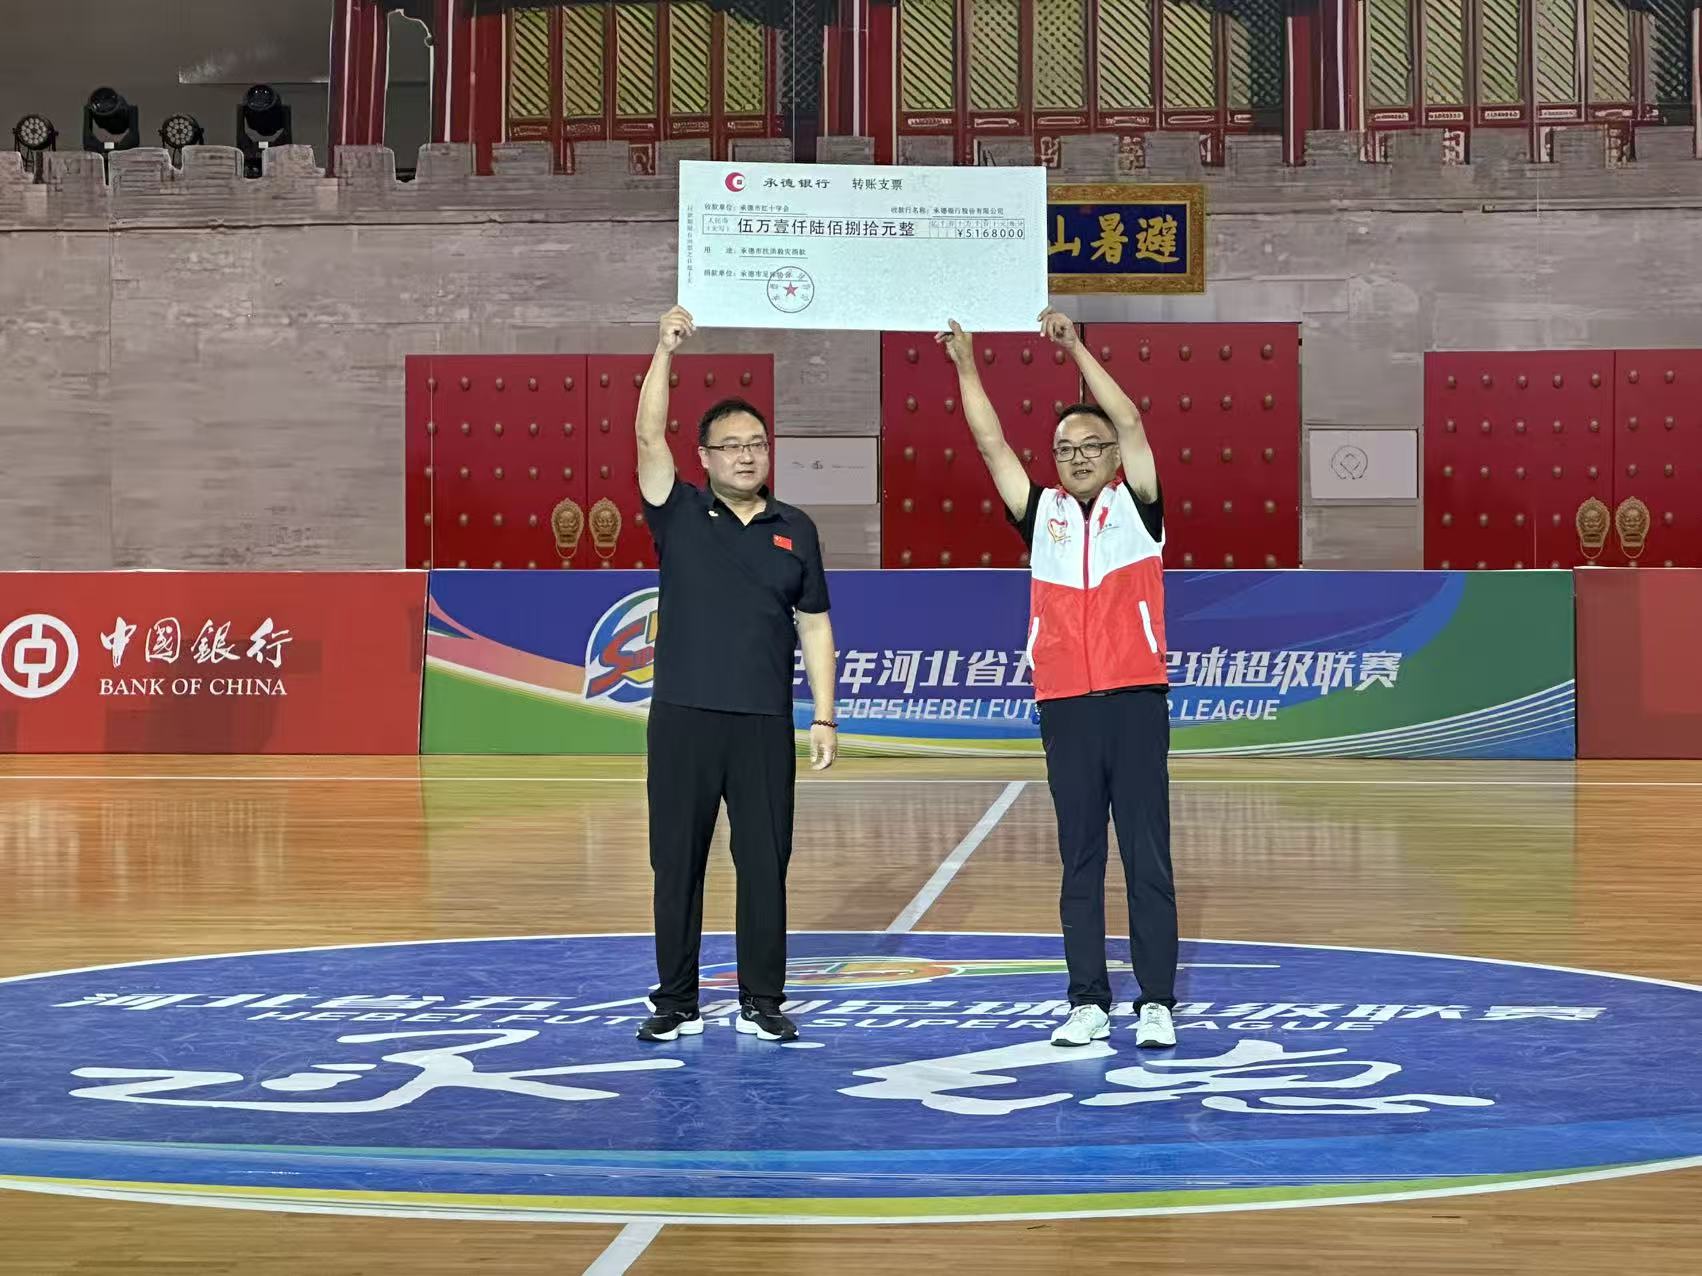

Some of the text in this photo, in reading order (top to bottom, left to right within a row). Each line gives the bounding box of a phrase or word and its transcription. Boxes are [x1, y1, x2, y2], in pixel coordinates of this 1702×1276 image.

[763, 177, 904, 191] 承德银行 转账支票
[737, 217, 915, 237] 伍万壹仟陆佰捌拾元整
[99, 616, 294, 669] 中國銀行
[98, 677, 288, 696] BANK OF CHINA
[986, 698, 1037, 720] FUT
[1180, 699, 1280, 721] LEAGUE
[246, 1011, 482, 1023] HEBEI
[801, 1018, 1059, 1029] SUPER
